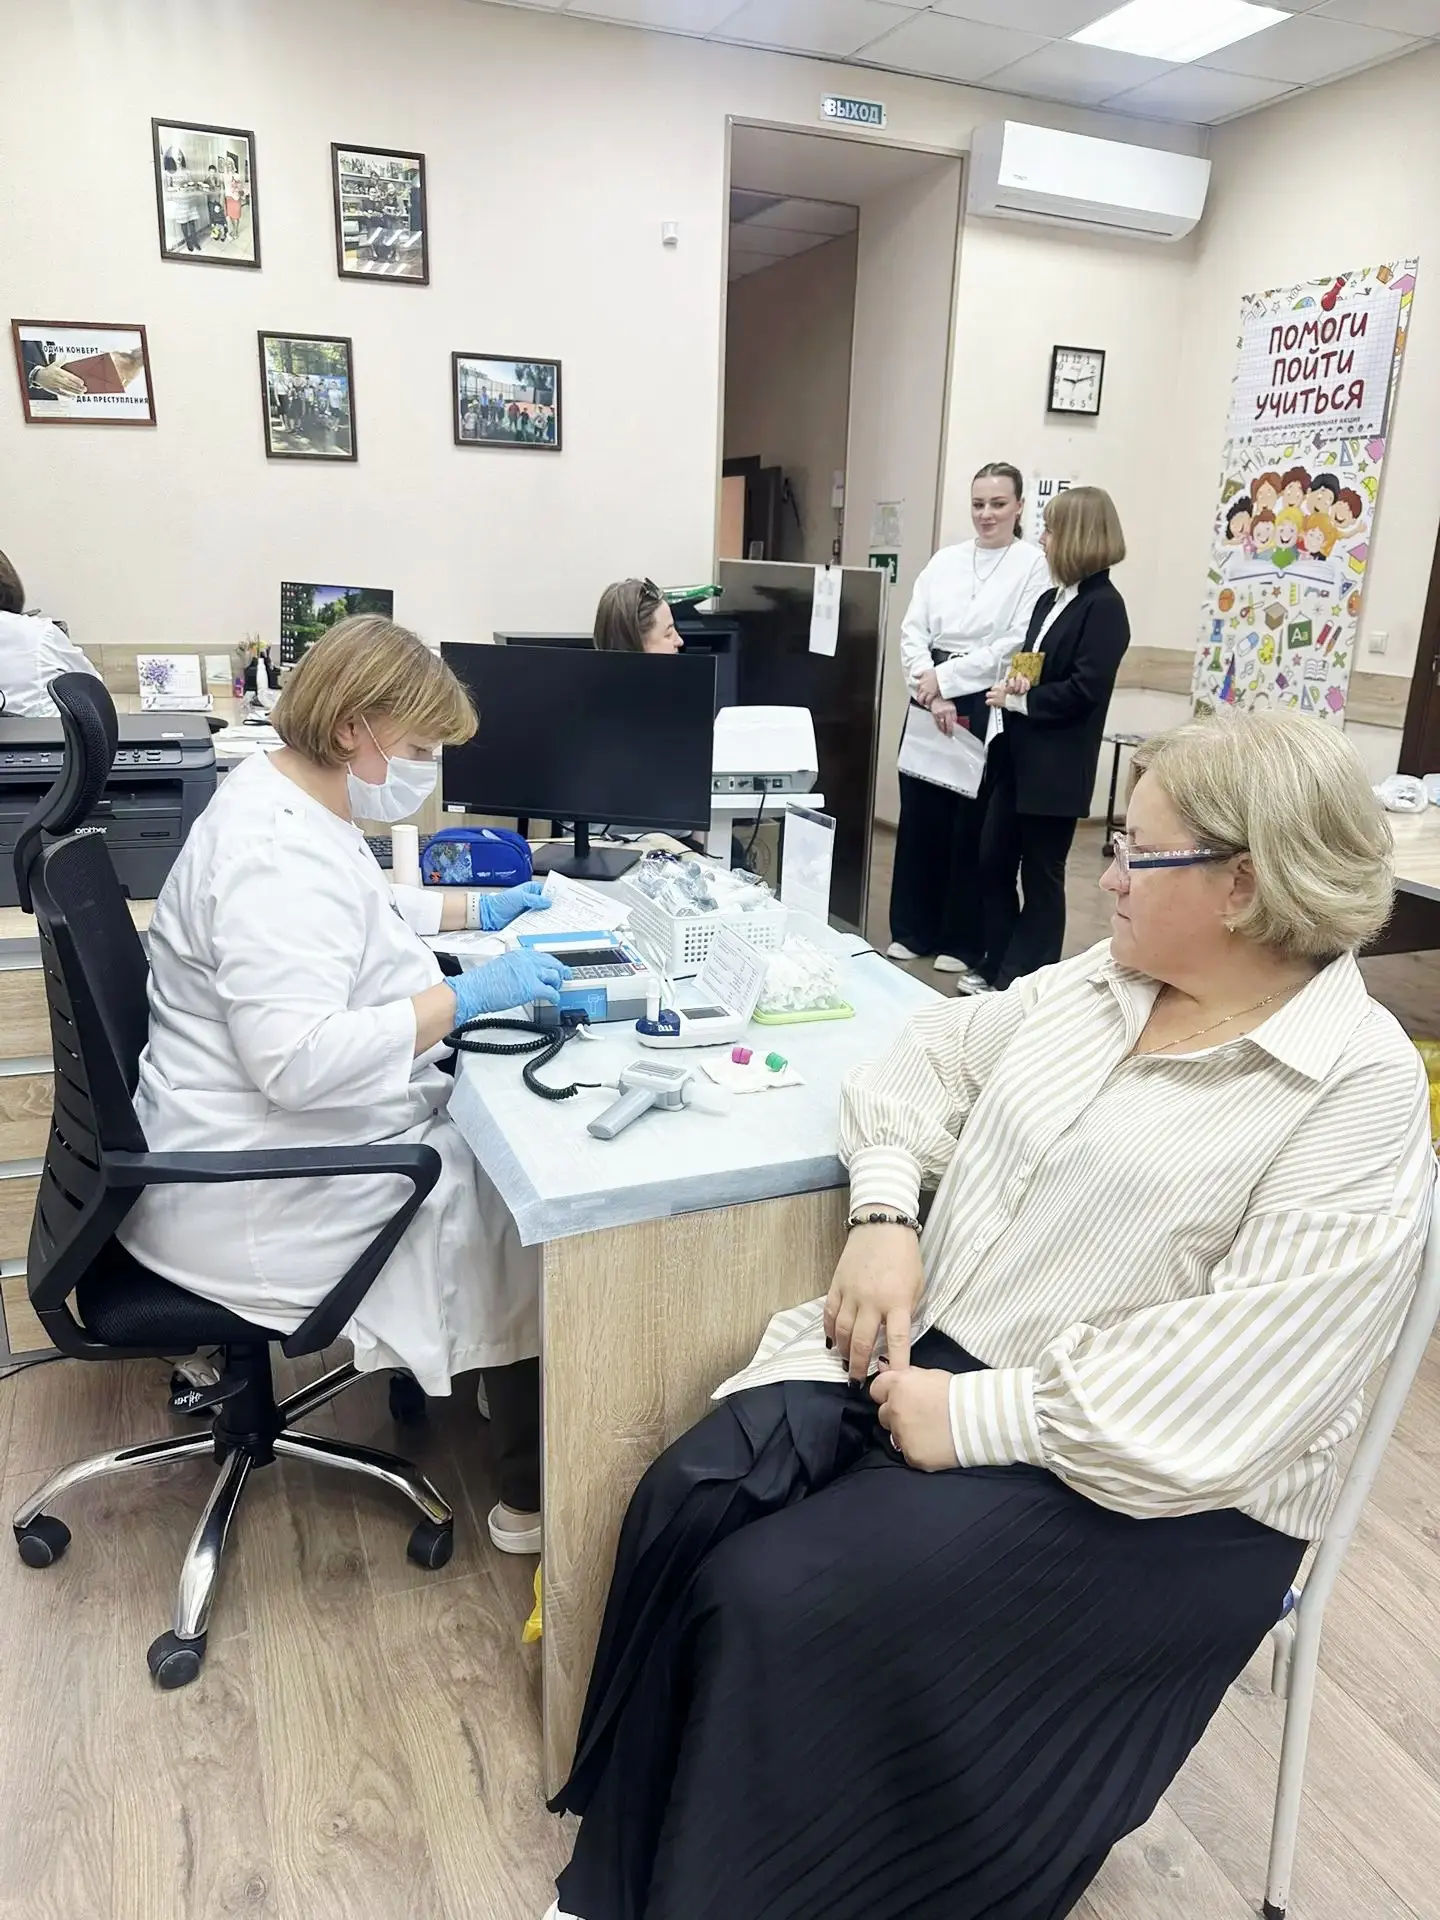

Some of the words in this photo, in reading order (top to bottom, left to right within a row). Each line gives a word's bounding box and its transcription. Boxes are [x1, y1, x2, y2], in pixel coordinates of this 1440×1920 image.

[824, 98, 880, 124] ВЫХОД
[1268, 312, 1369, 355] ПОМОГИ
[43, 345, 64, 353] ОДИН
[66, 346, 98, 354] КОНВЕРТ
[1272, 347, 1355, 387] ПОЙТИ
[76, 395, 92, 403] ДВА
[93, 395, 150, 404] ПРЕСТУПЛЕНИЯ
[1254, 379, 1365, 420] УЧИТЬСЯ
[1038, 480, 1053, 496] Ш
